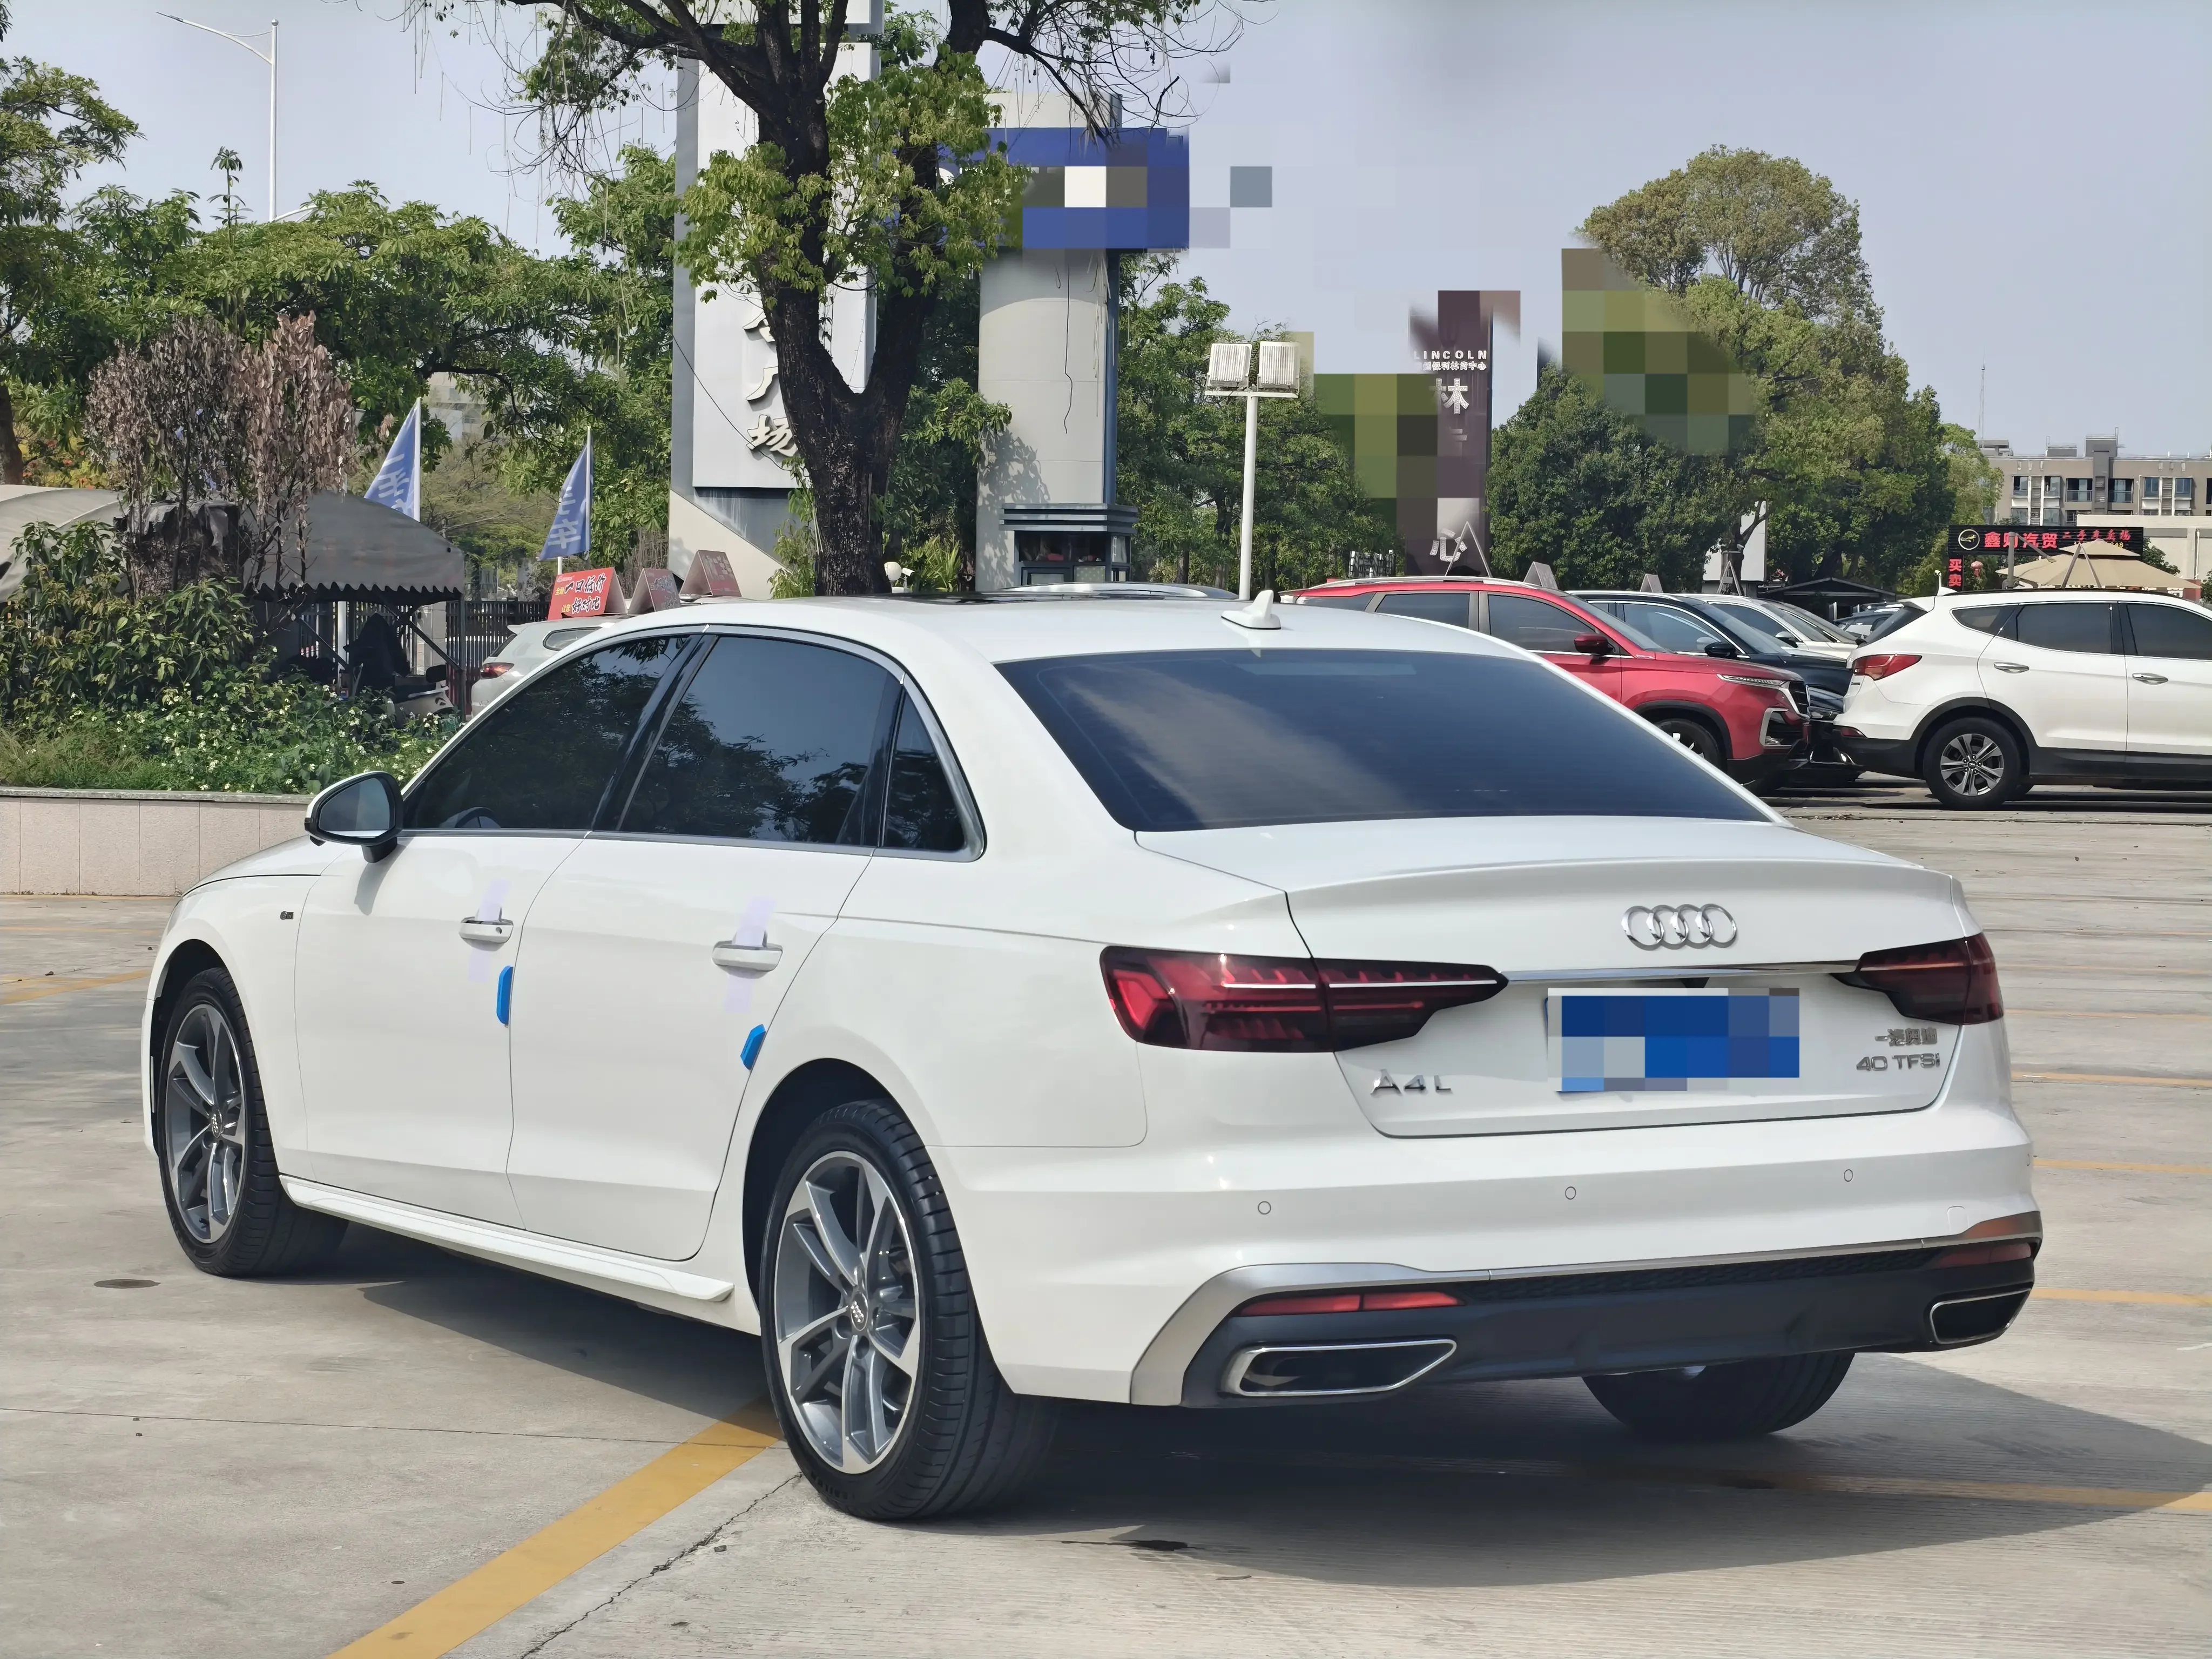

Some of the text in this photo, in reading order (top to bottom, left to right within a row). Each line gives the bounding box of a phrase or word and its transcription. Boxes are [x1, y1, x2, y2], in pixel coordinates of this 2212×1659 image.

[1414, 350, 1487, 360] LINCOLN
[1948, 558, 1962, 587] 买卖
[1856, 1056, 1888, 1071] 40
